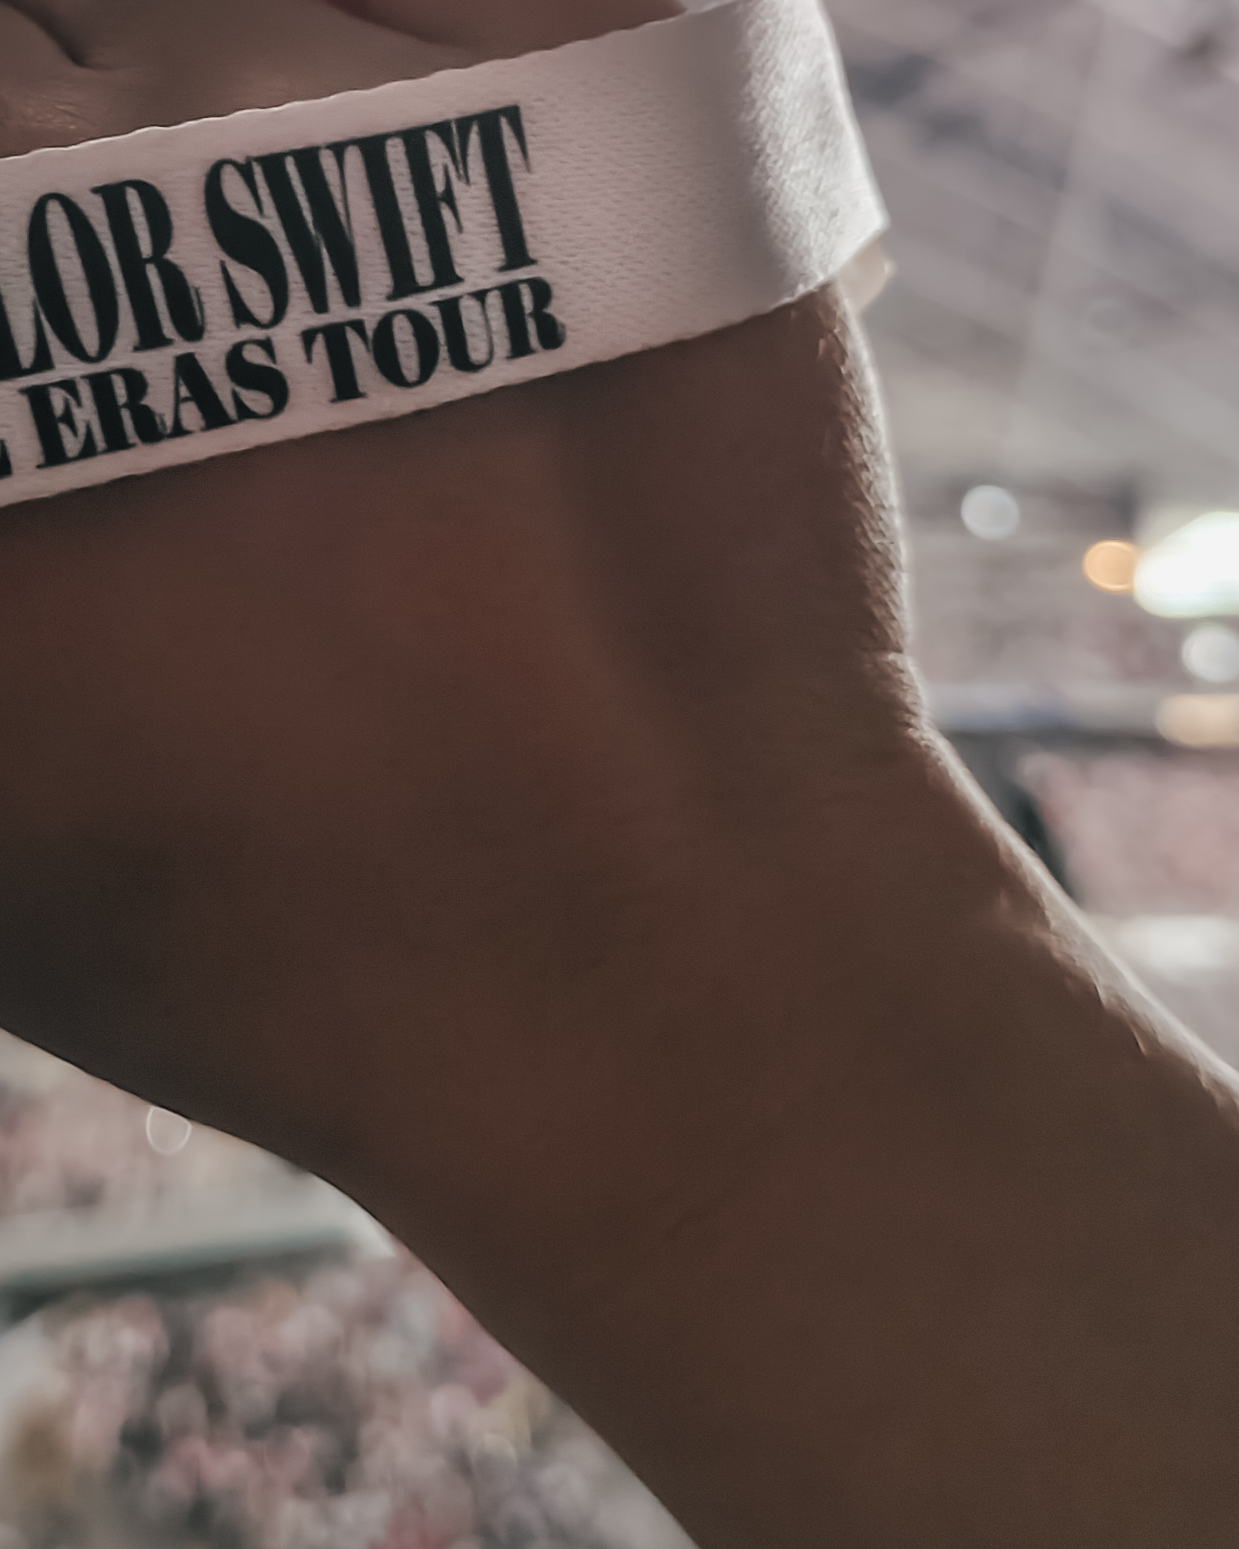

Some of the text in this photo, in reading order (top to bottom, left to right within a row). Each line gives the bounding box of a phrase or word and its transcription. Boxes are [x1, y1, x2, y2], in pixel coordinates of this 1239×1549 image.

[205, 105, 538, 330] SWIFT
[18, 336, 290, 469] ERAS
[302, 276, 566, 403] TOUR
